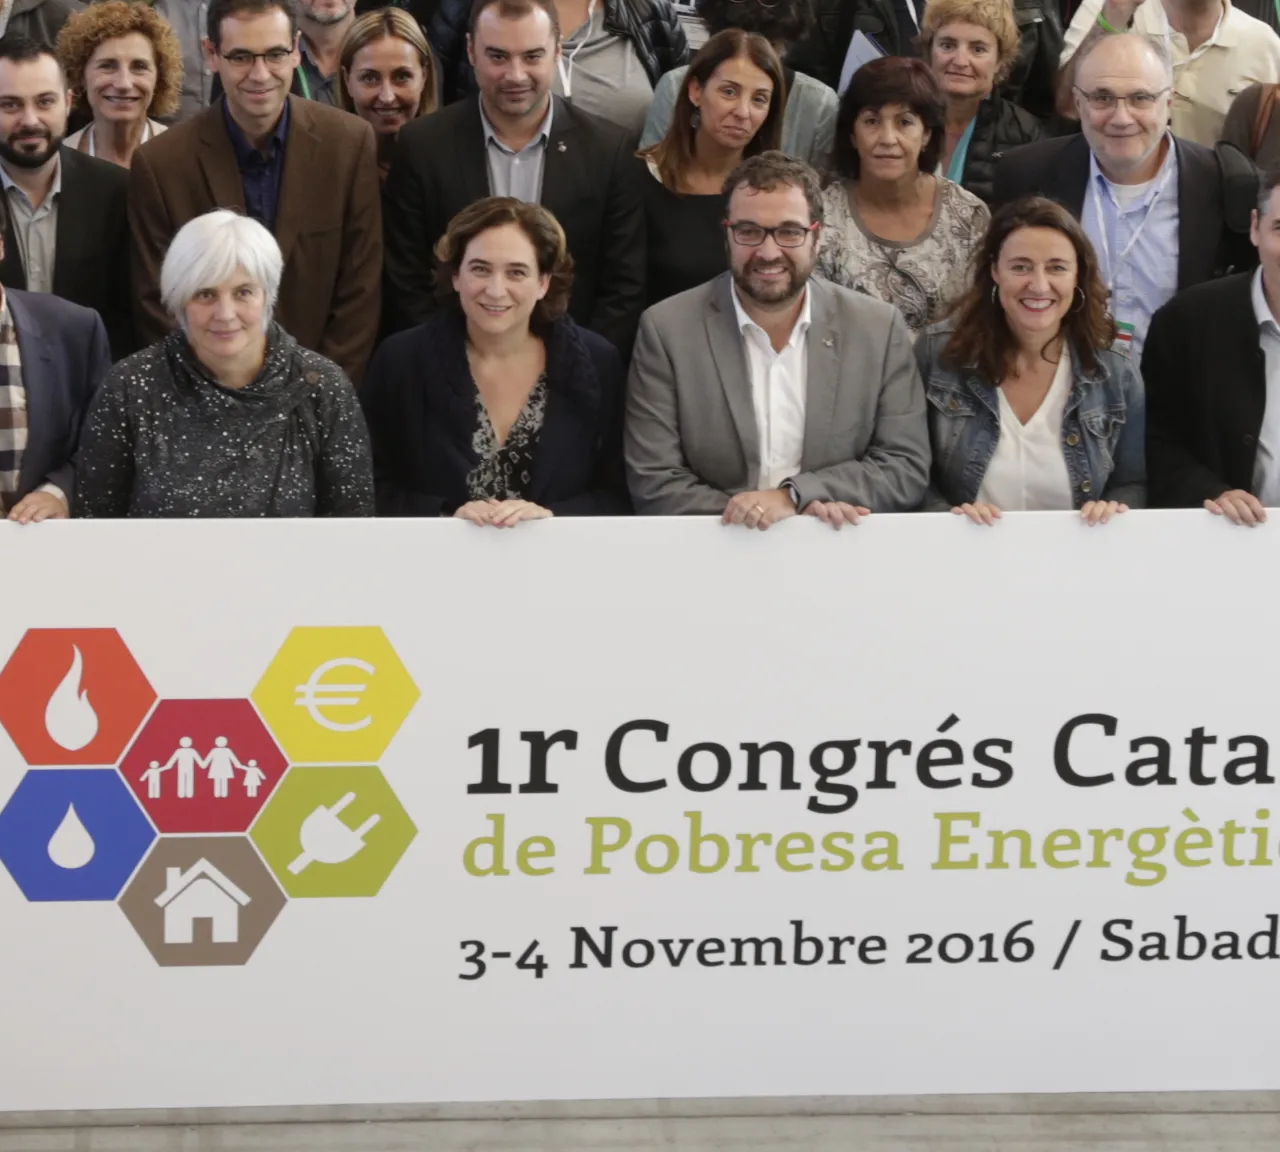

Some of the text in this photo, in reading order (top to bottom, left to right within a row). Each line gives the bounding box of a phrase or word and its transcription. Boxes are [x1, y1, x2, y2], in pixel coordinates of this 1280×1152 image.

[465, 726, 580, 795] 1r
[603, 711, 1015, 816] Congrés
[463, 812, 557, 878] de
[582, 809, 906, 876] Pobresa
[458, 938, 550, 981] 3-4
[567, 918, 888, 970] Novembre
[904, 918, 1036, 966] 2016
[1051, 918, 1083, 972] /
